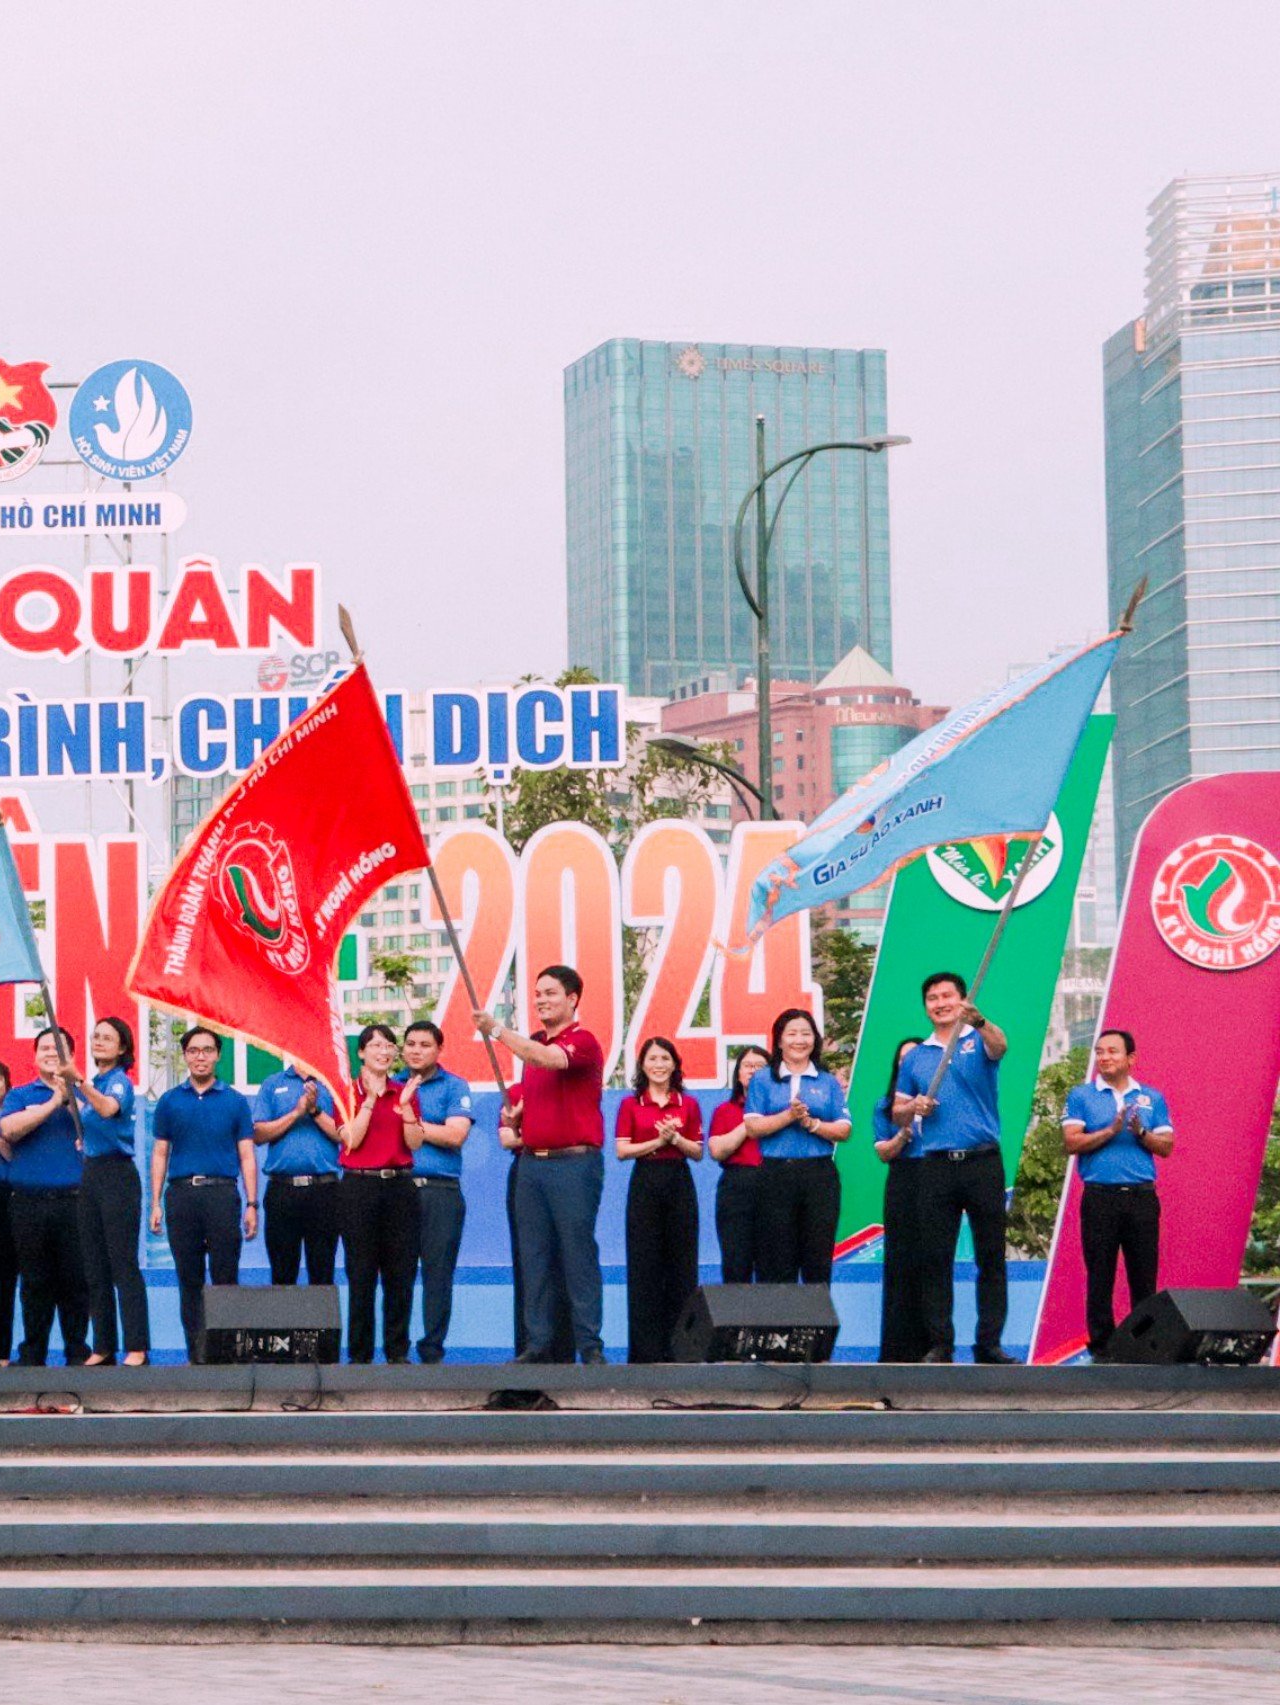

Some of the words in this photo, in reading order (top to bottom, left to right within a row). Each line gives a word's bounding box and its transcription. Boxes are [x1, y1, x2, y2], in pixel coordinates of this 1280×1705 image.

[89, 455, 116, 474] SINH
[169, 429, 188, 456] NAM
[1, 498, 33, 528] HỒ
[44, 501, 85, 527] CHÍ
[96, 503, 161, 526] MINH
[295, 702, 339, 742] MINH
[434, 692, 618, 778] DỊCH
[813, 862, 847, 886] GIA
[892, 796, 943, 828] XANH
[178, 880, 206, 930] ĐOÀN
[164, 919, 193, 976] THÀNH
[430, 824, 812, 1085] 2024
[1162, 915, 1187, 939] KỲ
[1183, 942, 1234, 964] NGHỈ
